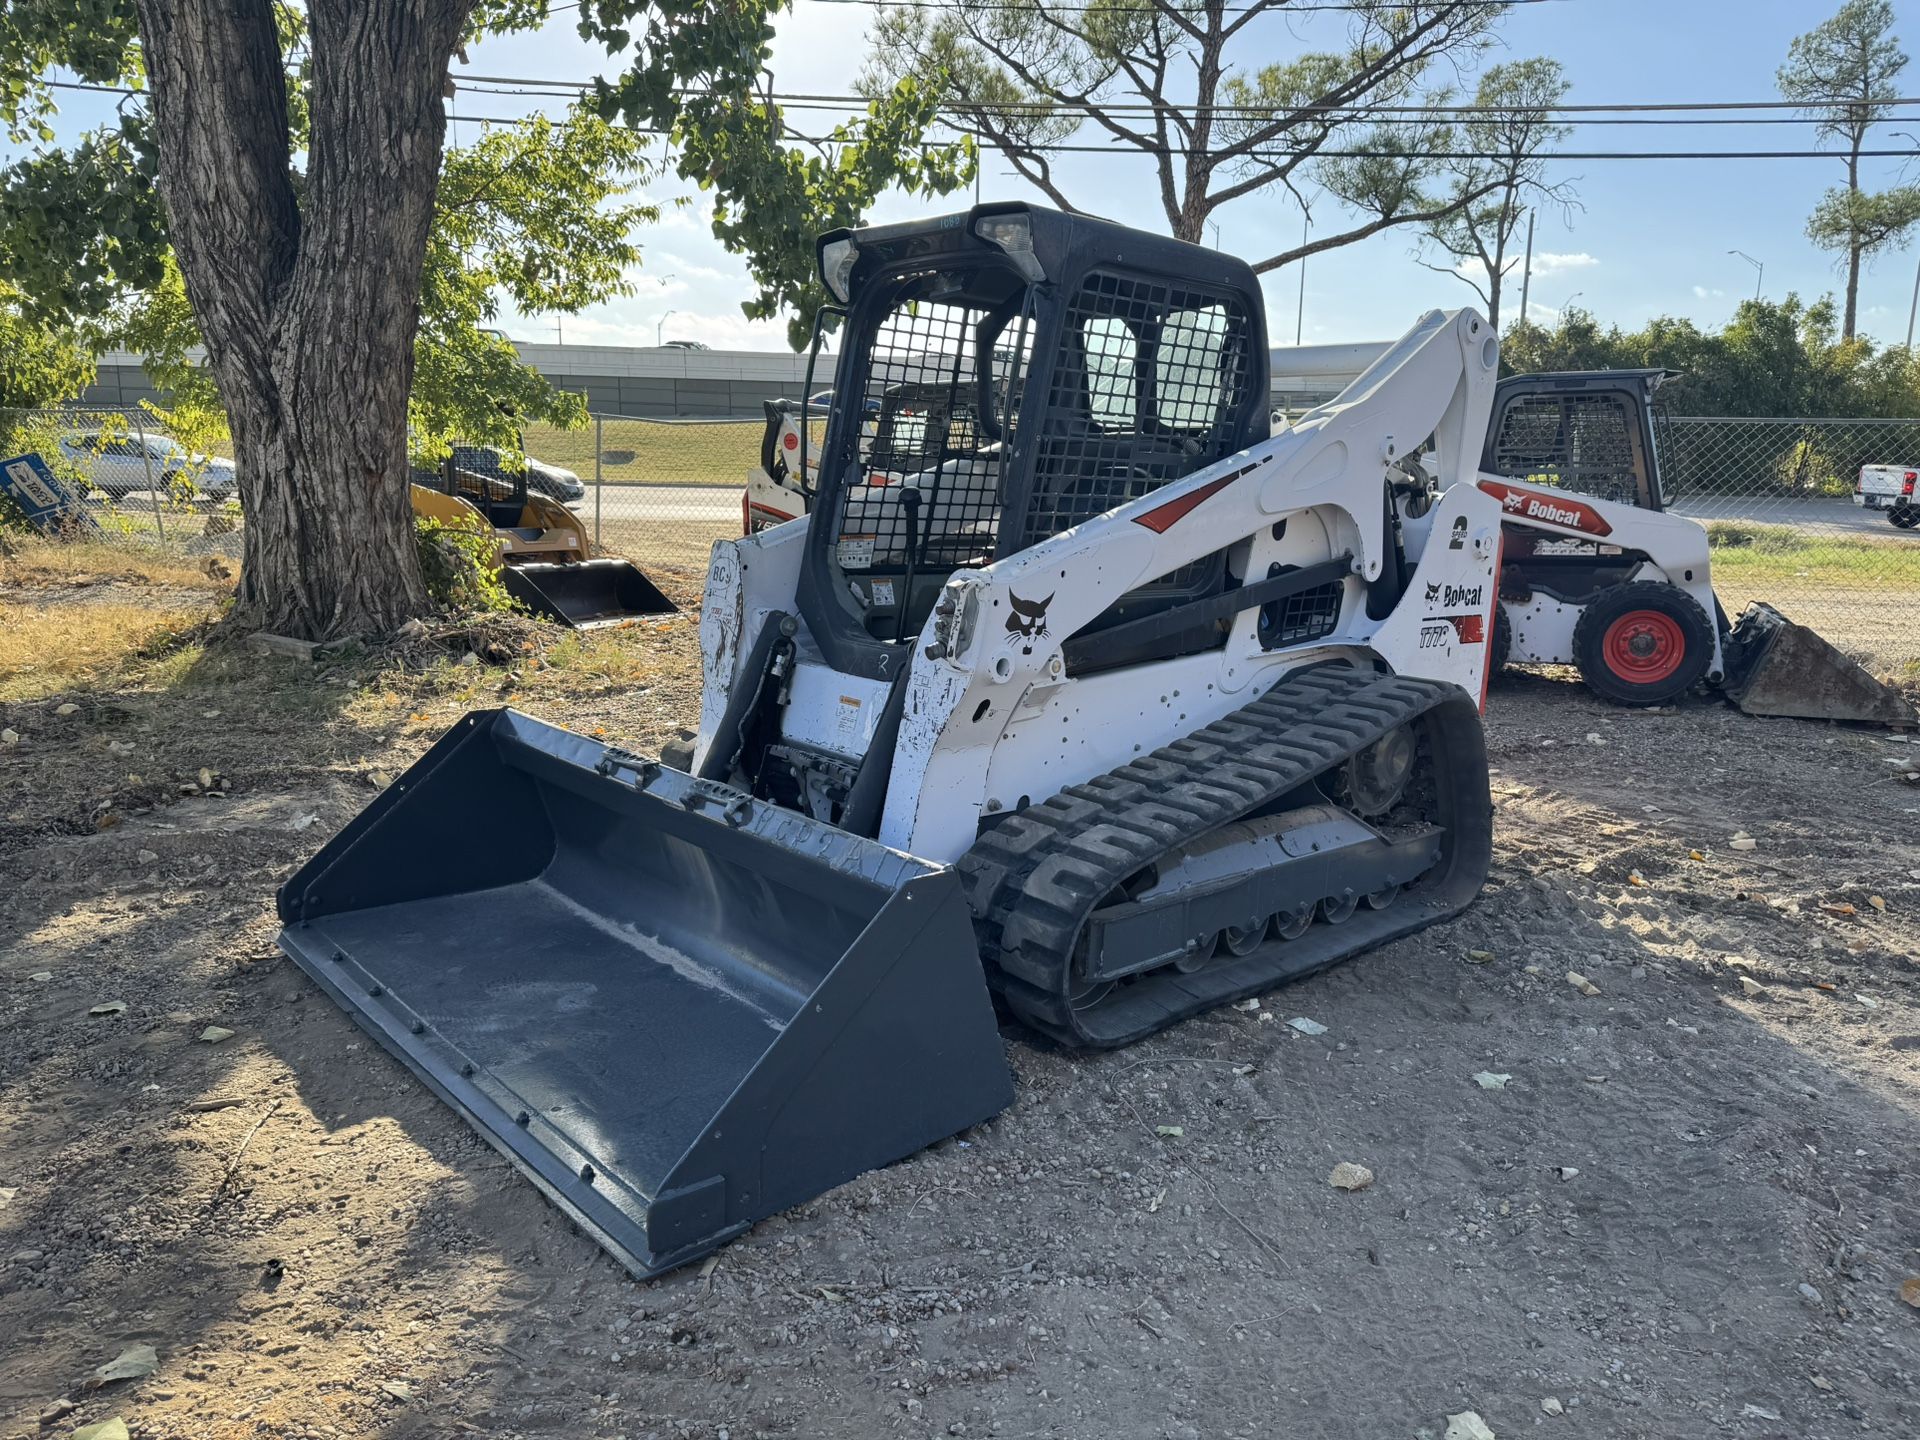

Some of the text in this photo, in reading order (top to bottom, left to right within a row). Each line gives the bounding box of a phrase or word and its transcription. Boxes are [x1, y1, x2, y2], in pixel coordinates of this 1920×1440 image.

[1526, 499, 1582, 527] Bobcat
[1448, 515, 1468, 550] 2
[1451, 530, 1468, 539] SPEED
[1444, 584, 1483, 608] Bobcat
